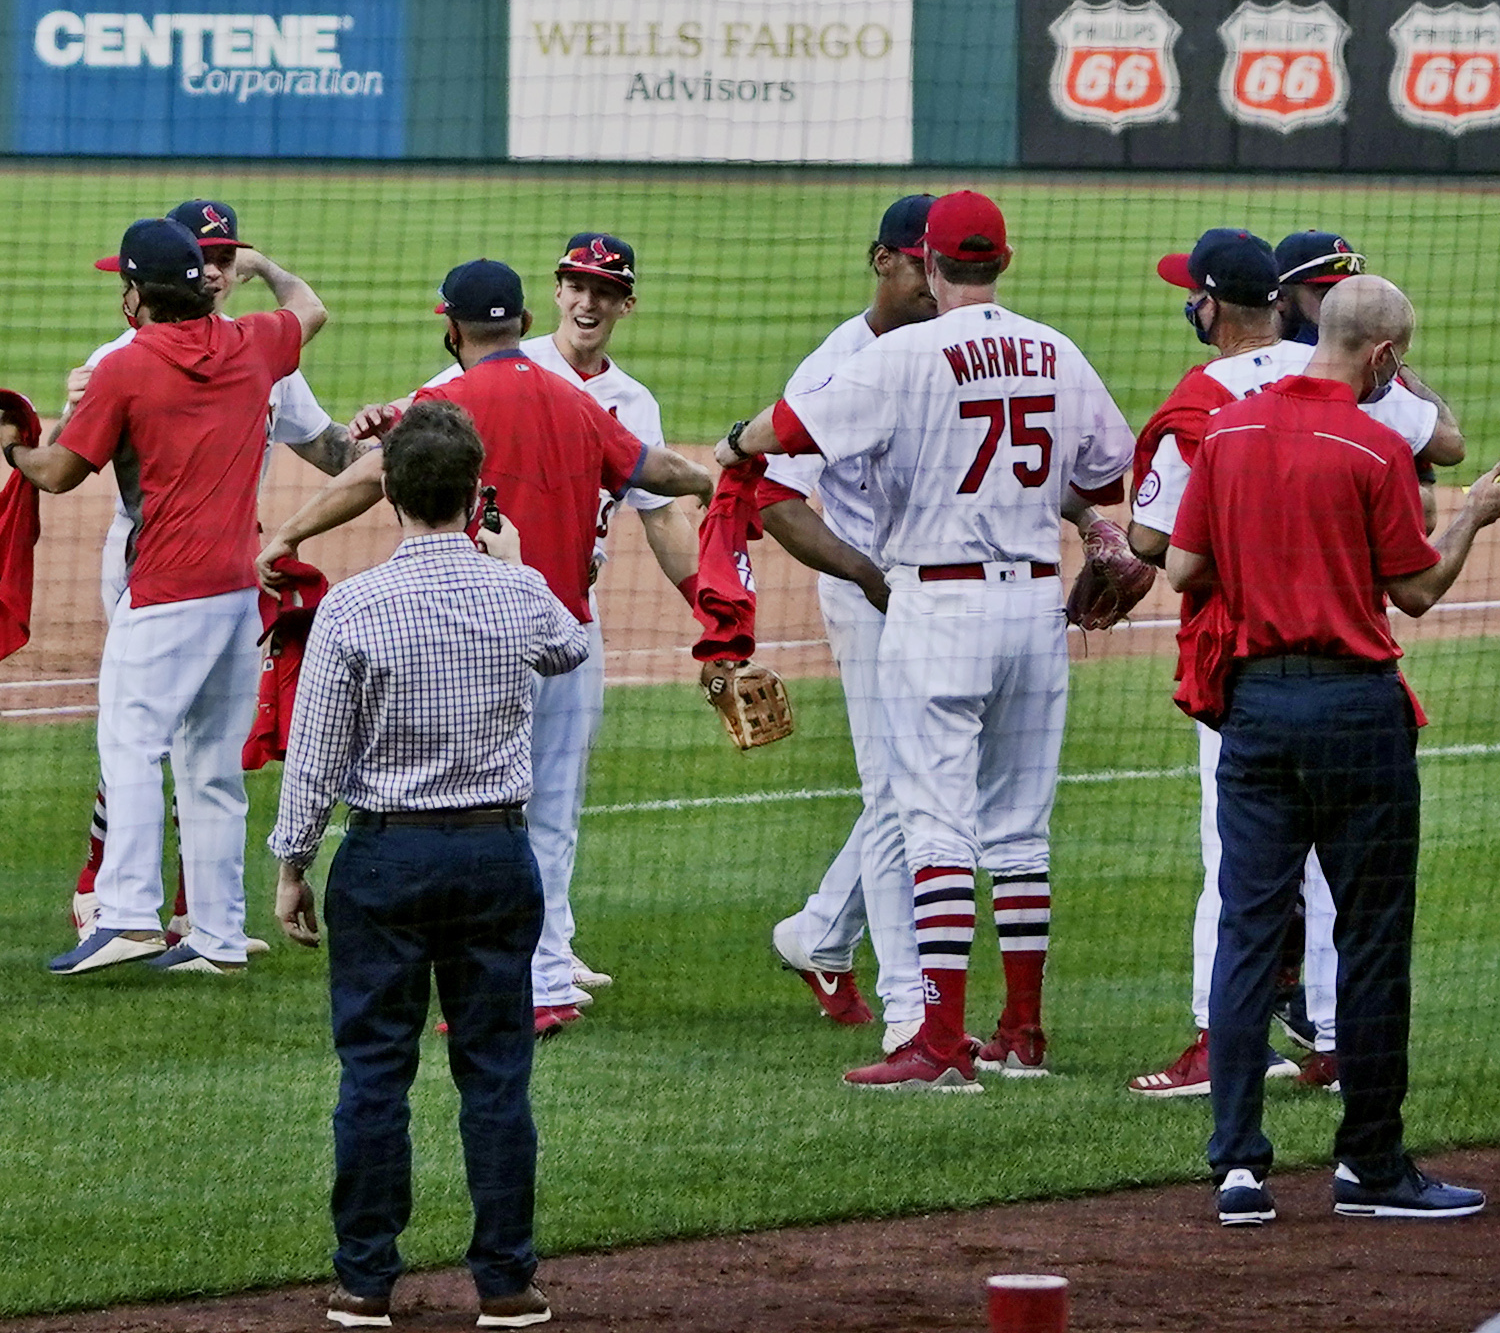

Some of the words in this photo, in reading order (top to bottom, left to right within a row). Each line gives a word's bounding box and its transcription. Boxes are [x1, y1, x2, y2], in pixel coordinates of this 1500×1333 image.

[34, 11, 343, 68] CENTENE
[535, 22, 705, 60] WELLS
[722, 22, 893, 61] FARGO
[182, 63, 383, 101] Corporation
[626, 71, 796, 105] Advisors
[1075, 54, 1153, 100] 66
[1244, 55, 1321, 102] 66
[1414, 57, 1491, 105] 66
[943, 336, 1056, 385] WARNER
[956, 394, 1057, 495] 75
